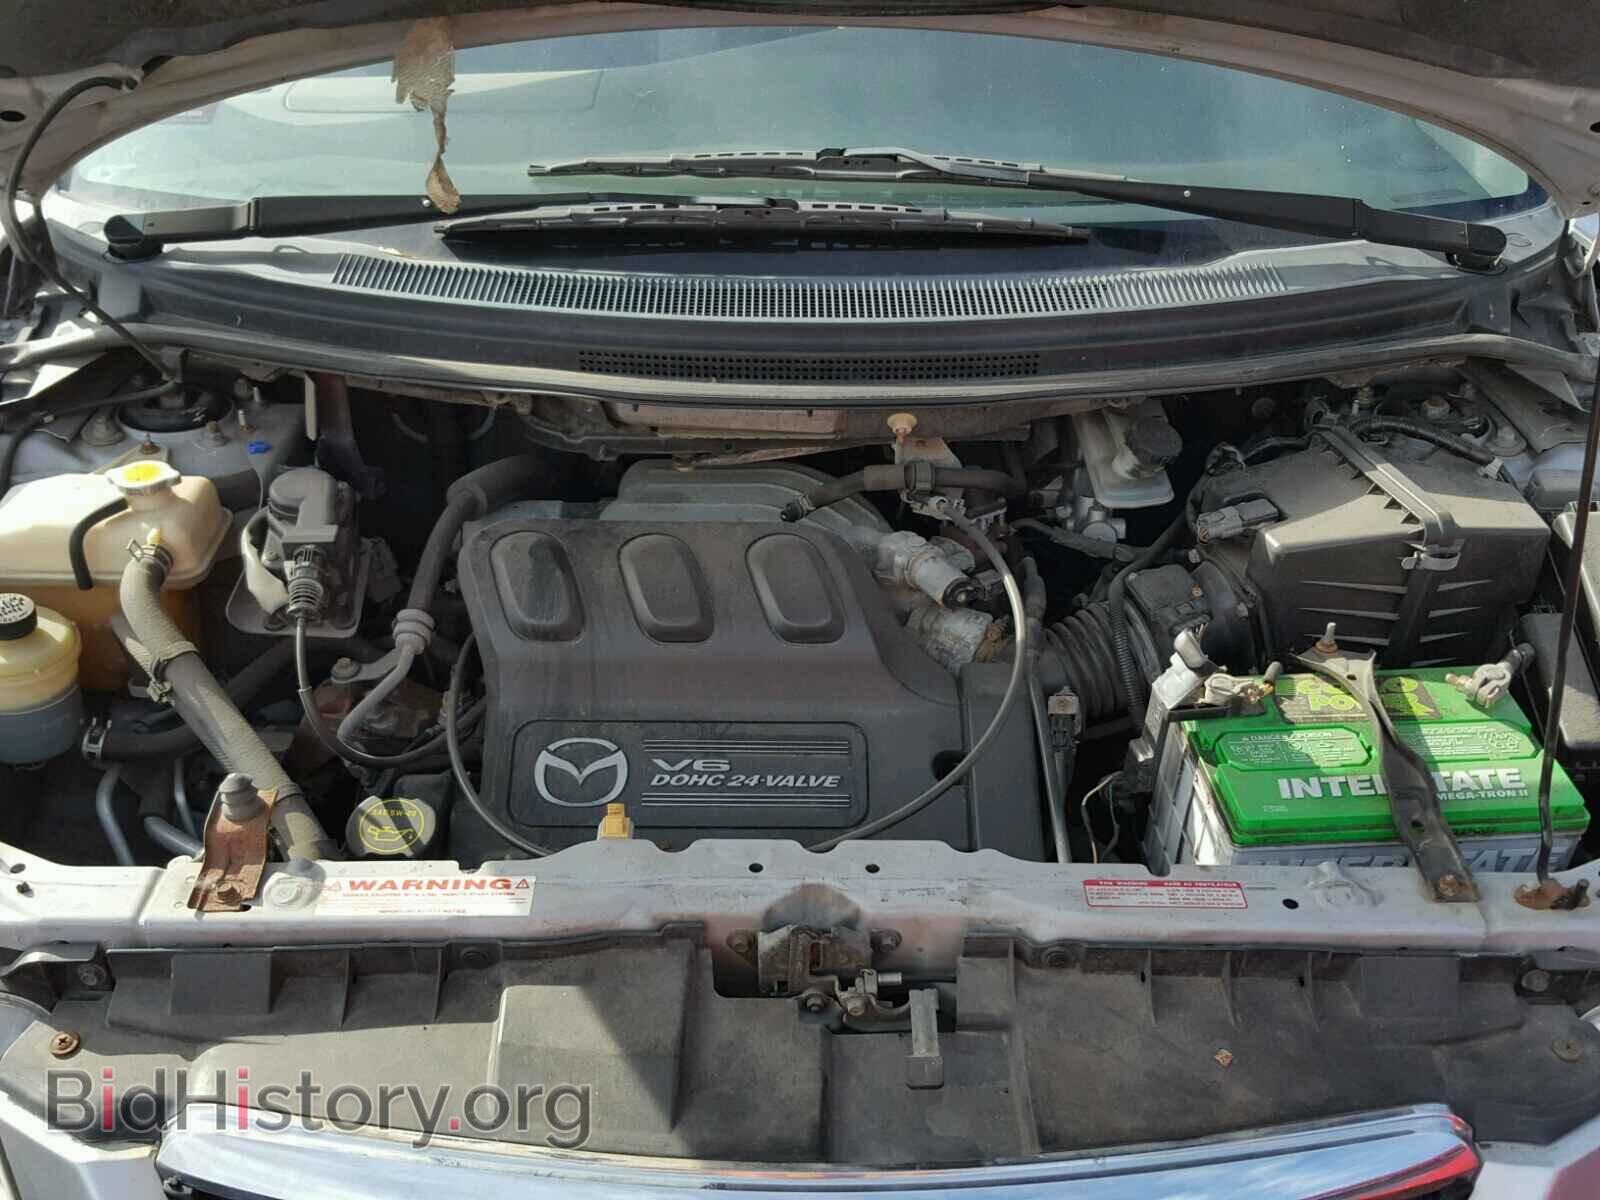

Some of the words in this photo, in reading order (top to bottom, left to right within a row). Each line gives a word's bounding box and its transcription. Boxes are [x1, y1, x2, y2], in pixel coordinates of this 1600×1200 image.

[651, 758, 731, 772] V6
[650, 773, 725, 788] DOHC
[1278, 767, 1526, 799] INTETATE
[349, 879, 512, 890] WARNING
